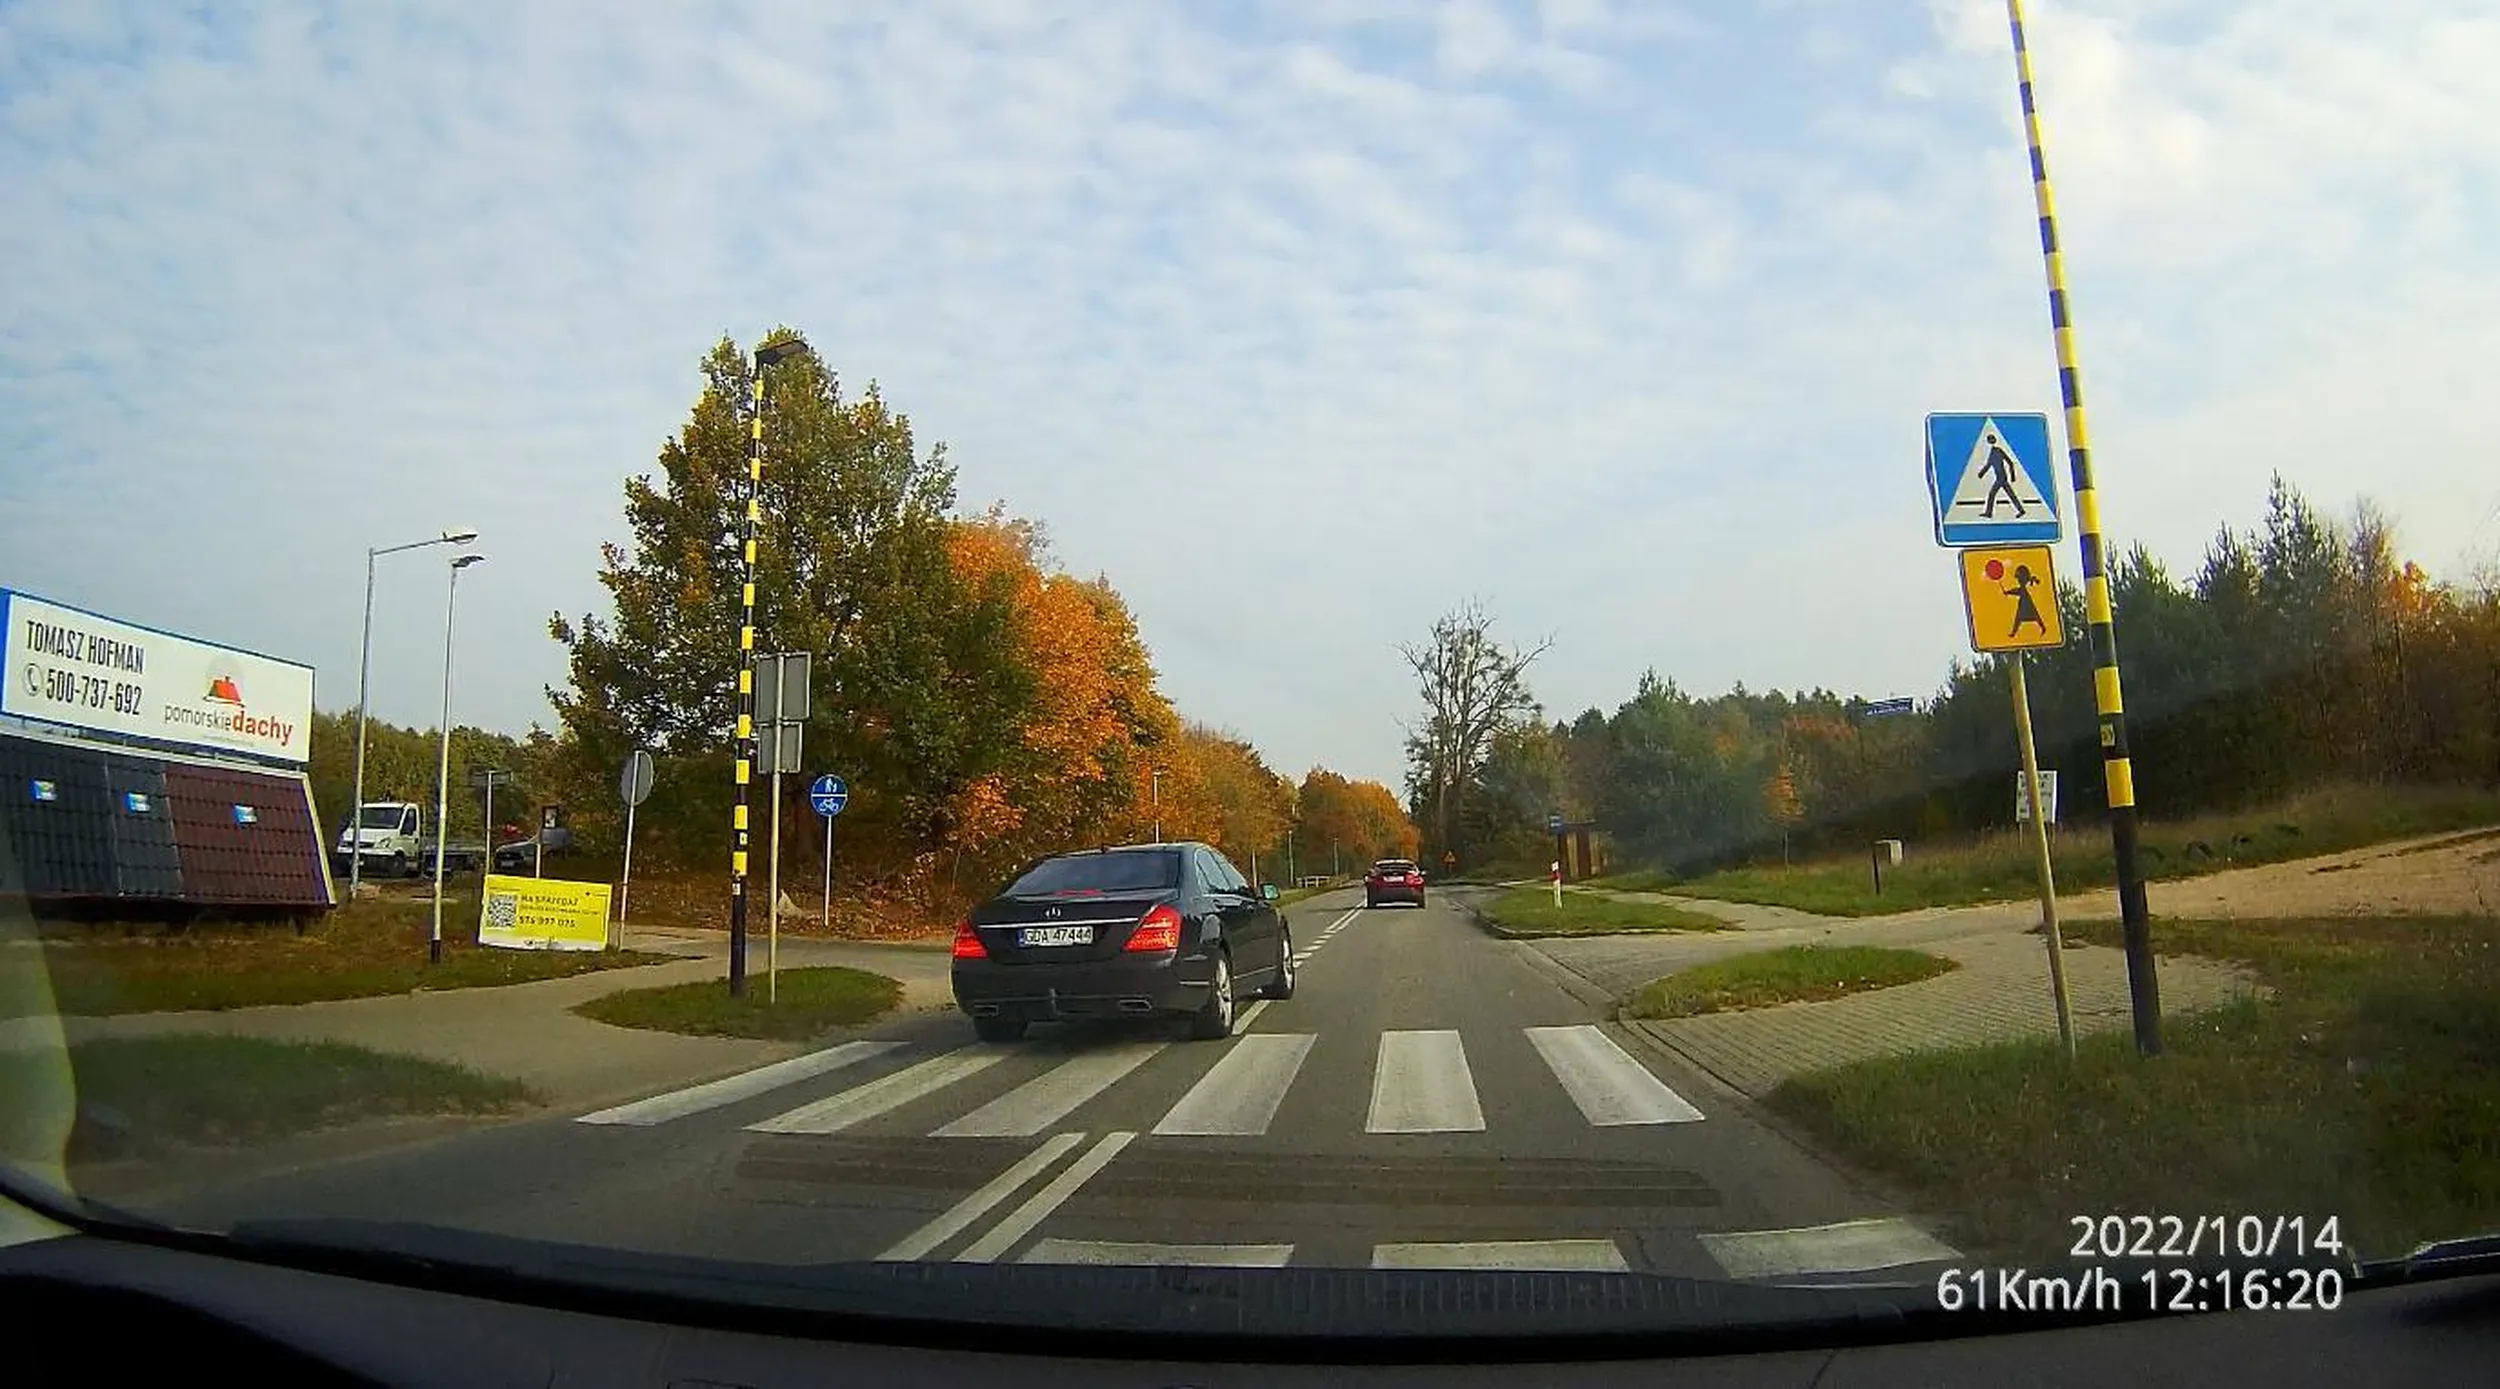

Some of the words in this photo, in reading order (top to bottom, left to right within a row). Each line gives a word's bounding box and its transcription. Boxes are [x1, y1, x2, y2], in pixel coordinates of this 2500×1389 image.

[26, 620, 86, 662] TOMASZ
[87, 634, 146, 675] HOFMAN
[46, 668, 144, 715] 500-737-692
[164, 704, 294, 747] pomorskiedachy
[1026, 930, 1048, 943] GDA
[1052, 927, 1092, 941] 47444
